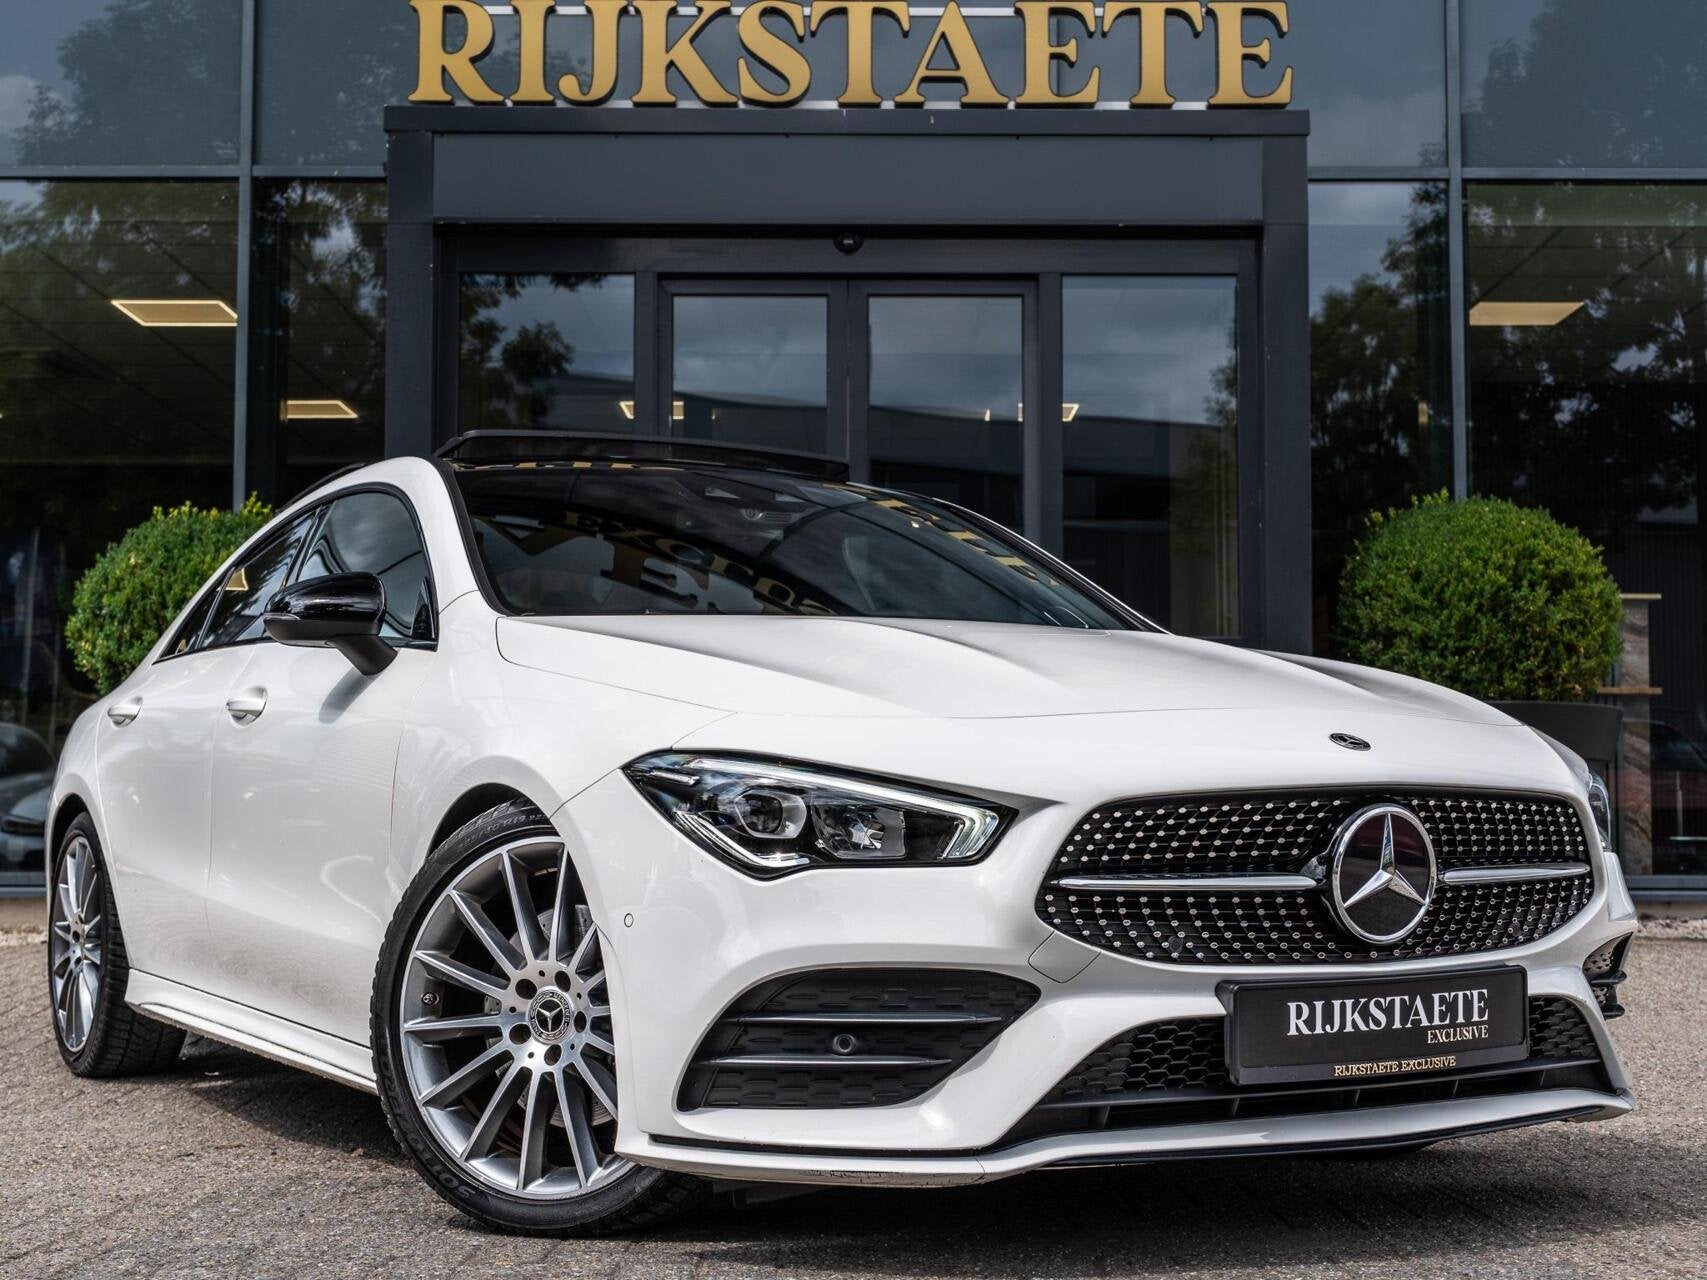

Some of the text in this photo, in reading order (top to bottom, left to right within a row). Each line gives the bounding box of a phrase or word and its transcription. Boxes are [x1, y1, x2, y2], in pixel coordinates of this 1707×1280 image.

[408, 0, 1293, 107] RIJKSTAETE
[1286, 989, 1489, 1036] RIJKSTAETE
[1427, 1025, 1489, 1044] EXCLUSIVE
[1334, 1056, 1457, 1077] RIJKSTAETE EXCLUSIVE
